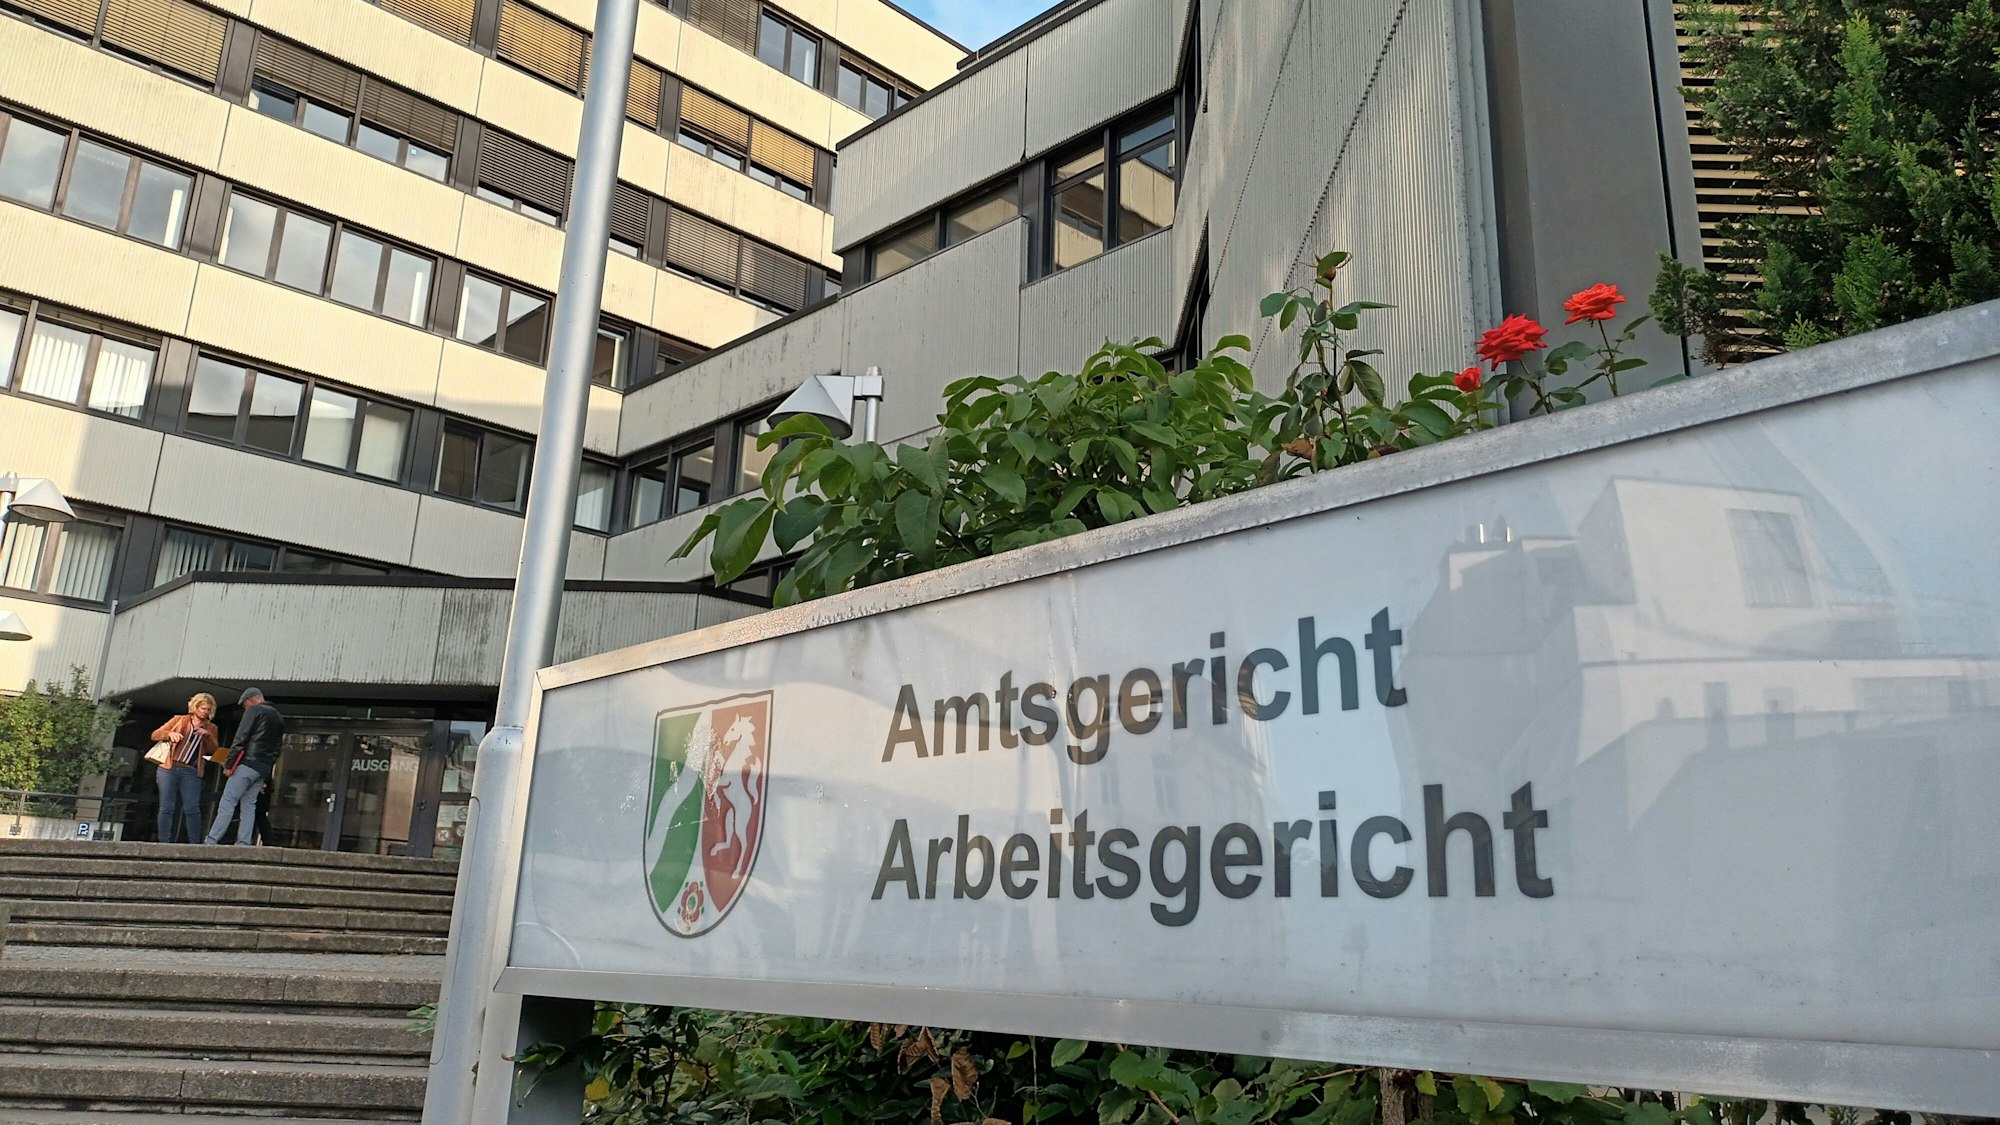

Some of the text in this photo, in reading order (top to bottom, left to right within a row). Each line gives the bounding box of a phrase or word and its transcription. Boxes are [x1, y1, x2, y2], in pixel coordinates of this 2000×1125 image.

[881, 606, 1409, 765] Amtsgericht
[351, 759, 419, 773] AUSGANG
[870, 781, 1556, 927] Arbeitsgericht
